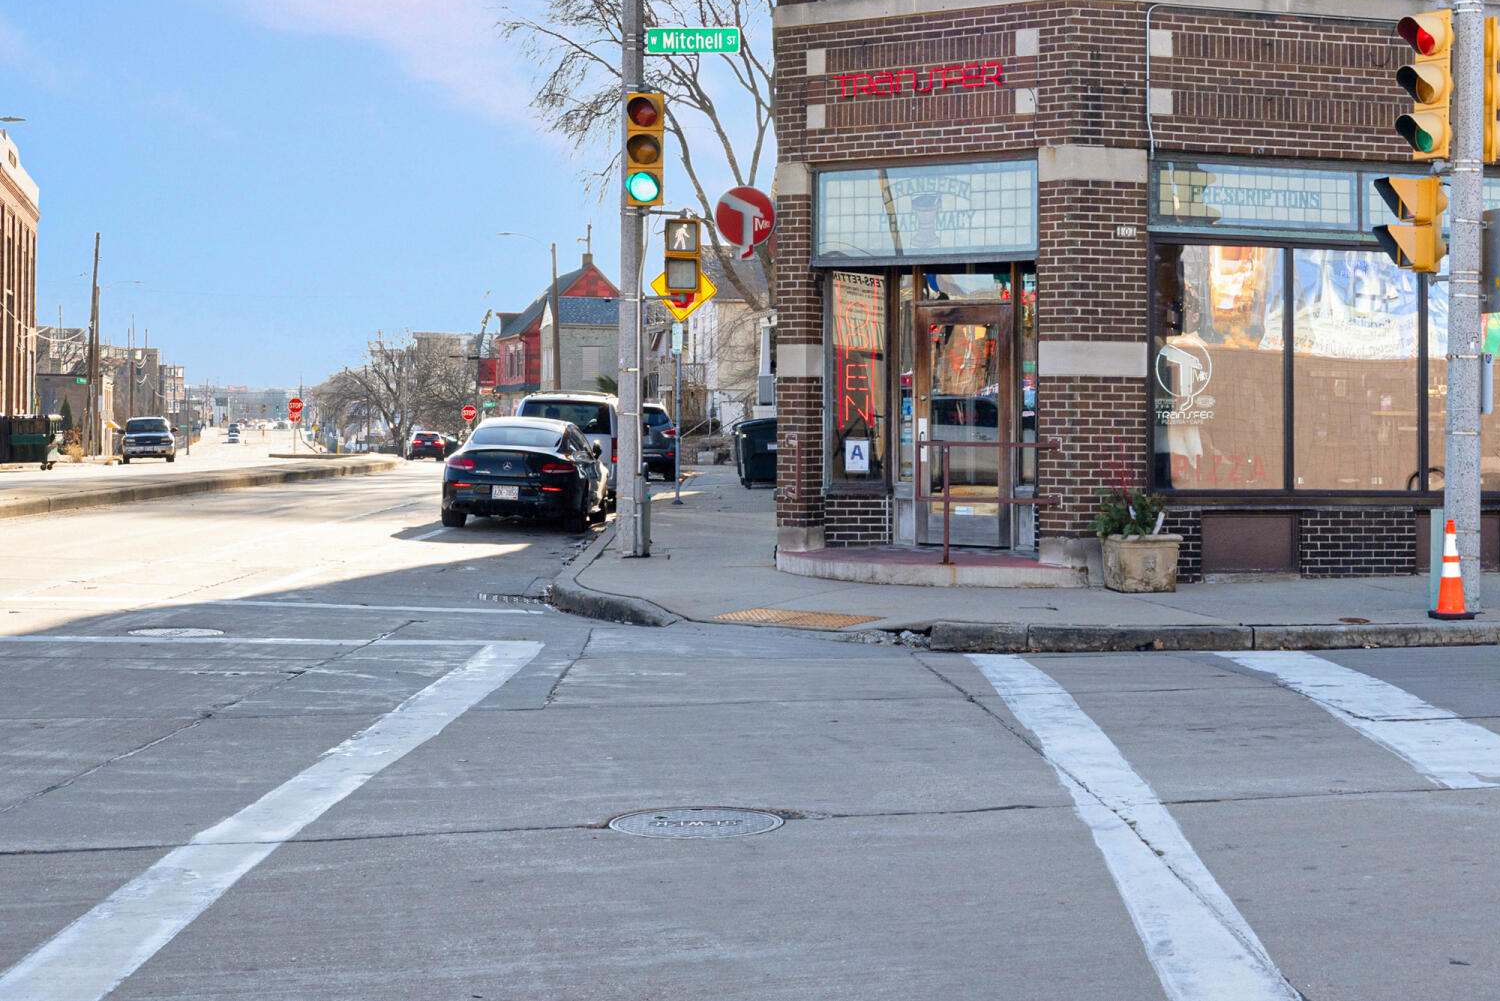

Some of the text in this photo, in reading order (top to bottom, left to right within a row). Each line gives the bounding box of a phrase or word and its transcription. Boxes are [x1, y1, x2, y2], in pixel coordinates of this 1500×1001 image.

[650, 32, 736, 49] W Mitchell ST
[1192, 185, 1320, 209] PRESCRIPTIONS
[845, 301, 870, 422] OPEN
[463, 409, 477, 417] STOP
[850, 444, 864, 461] A
[1172, 453, 1267, 482] PIZZA
